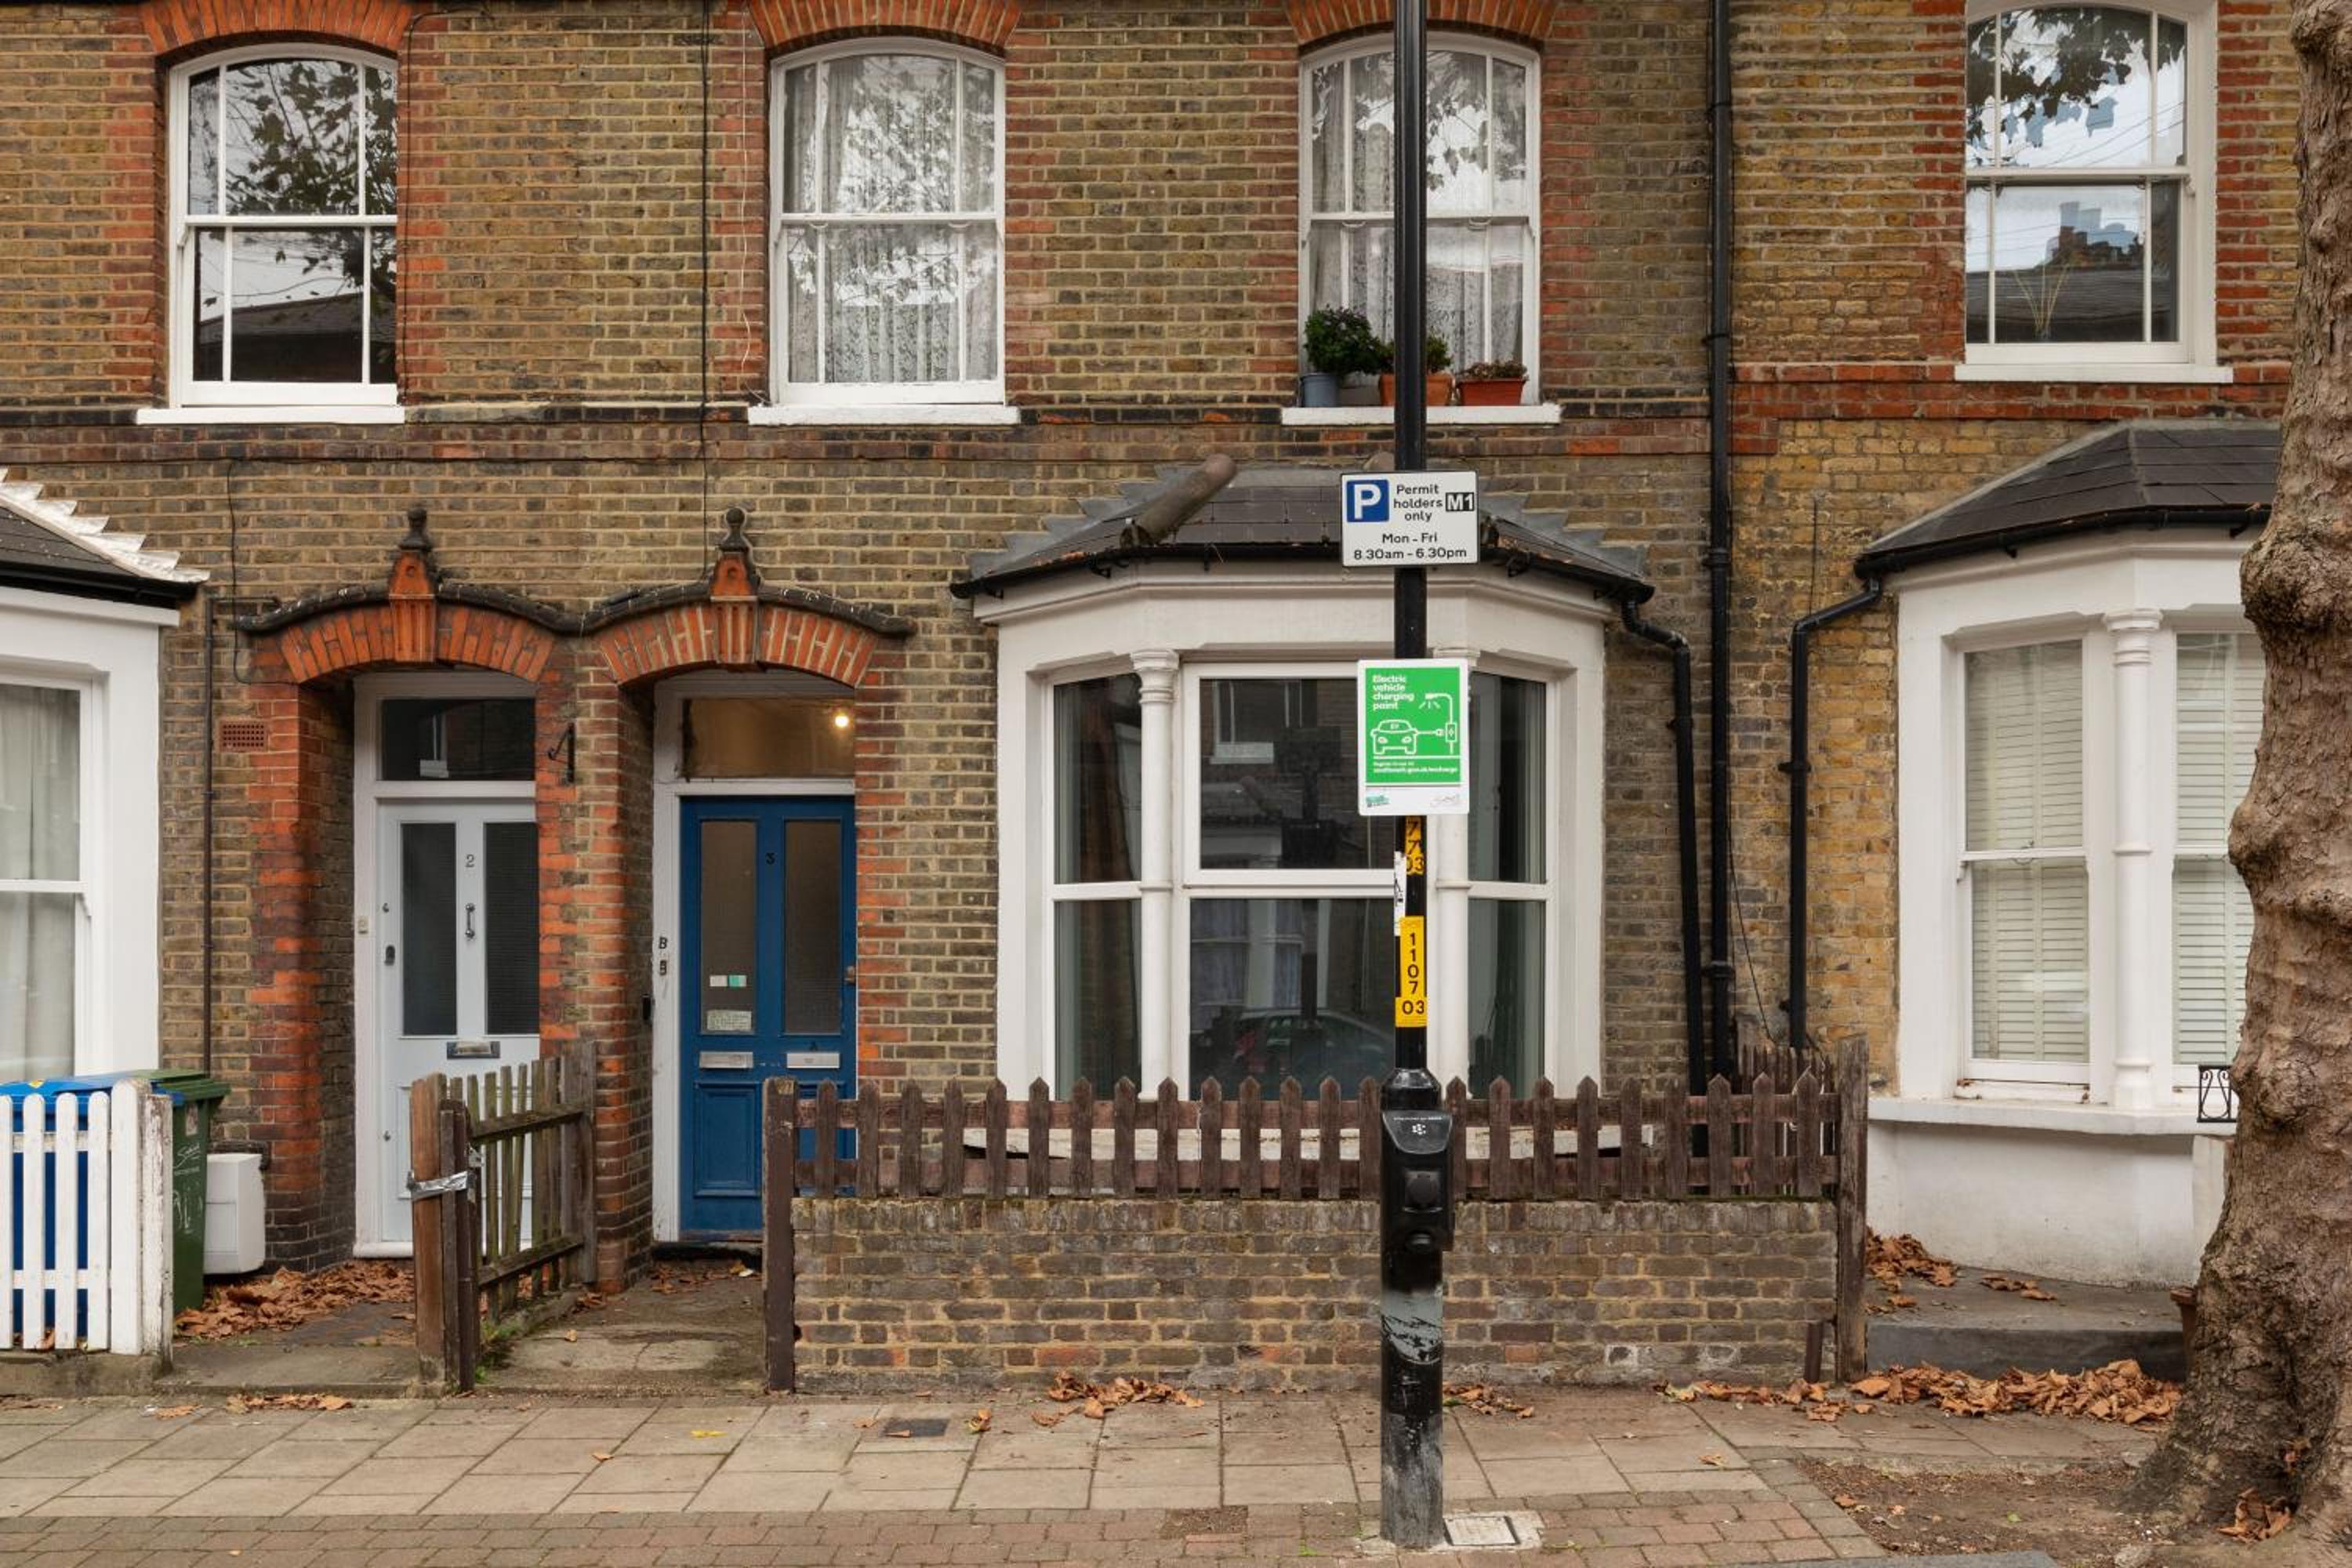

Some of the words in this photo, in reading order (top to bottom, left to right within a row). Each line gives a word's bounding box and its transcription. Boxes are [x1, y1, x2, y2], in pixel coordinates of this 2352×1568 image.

[1396, 485, 1439, 495] Permit
[1354, 484, 1381, 520] P
[1393, 498, 1443, 509] holders
[1446, 494, 1474, 510] M1
[1404, 511, 1432, 523] only
[1382, 534, 1410, 544] Mon
[1421, 532, 1437, 543] Fri
[1373, 692, 1414, 702] charging
[1373, 702, 1398, 711] point
[466, 854, 475, 868] 2
[1402, 1000, 1425, 1014] 03
